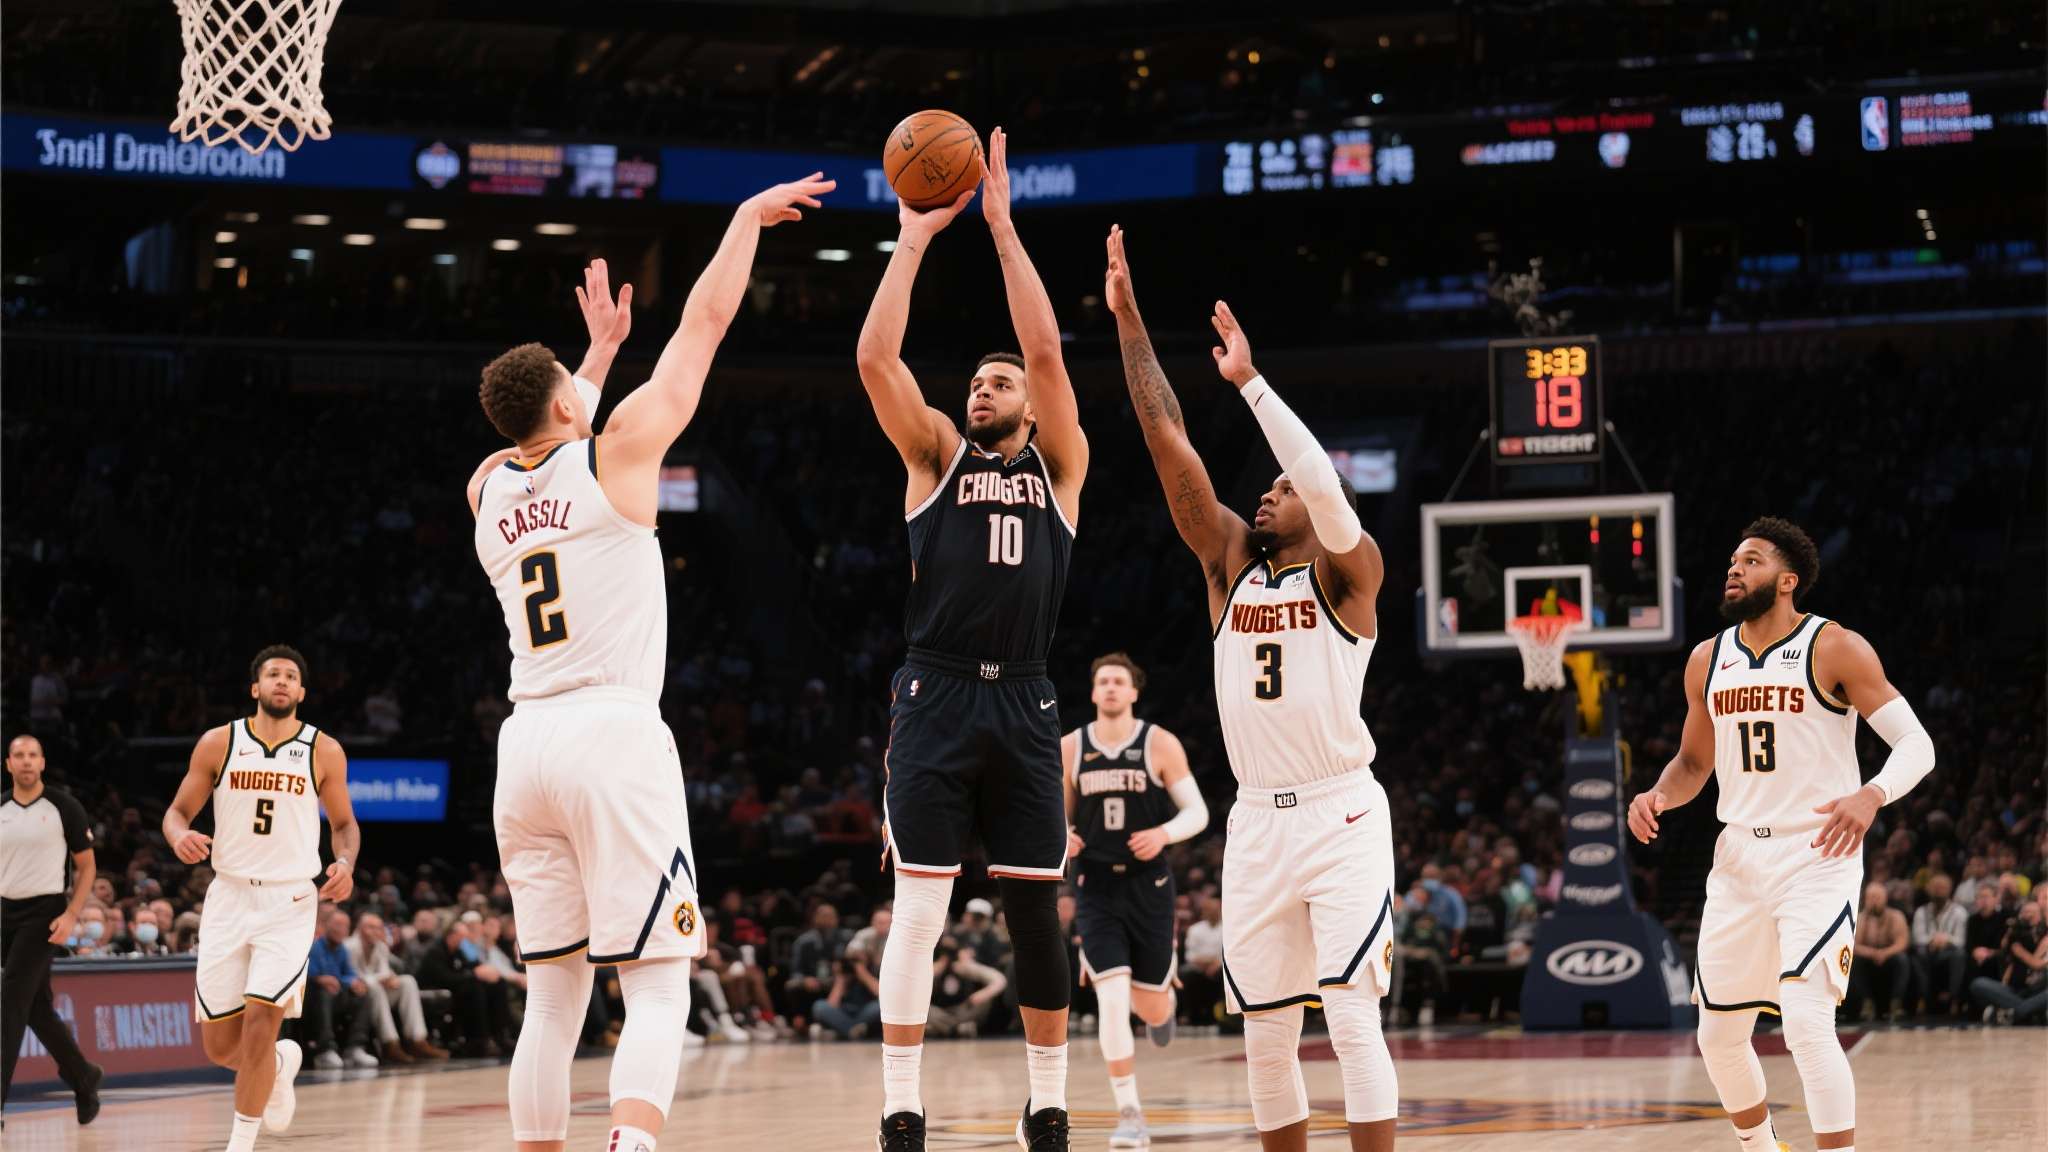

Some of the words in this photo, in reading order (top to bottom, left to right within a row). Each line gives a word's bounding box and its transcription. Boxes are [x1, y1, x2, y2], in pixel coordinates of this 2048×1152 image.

[1526, 346, 1587, 379] 3:33
[1535, 376, 1582, 428] 18
[498, 499, 572, 545] CASSLL
[988, 513, 1023, 566] 10
[520, 549, 571, 650] 2
[1231, 600, 1318, 634] NUGGETS
[1255, 642, 1283, 701] 3
[1713, 685, 1806, 717] NUGGETS
[1737, 720, 1777, 773] 13
[229, 770, 307, 796] NUGGETS
[253, 798, 275, 836] 5
